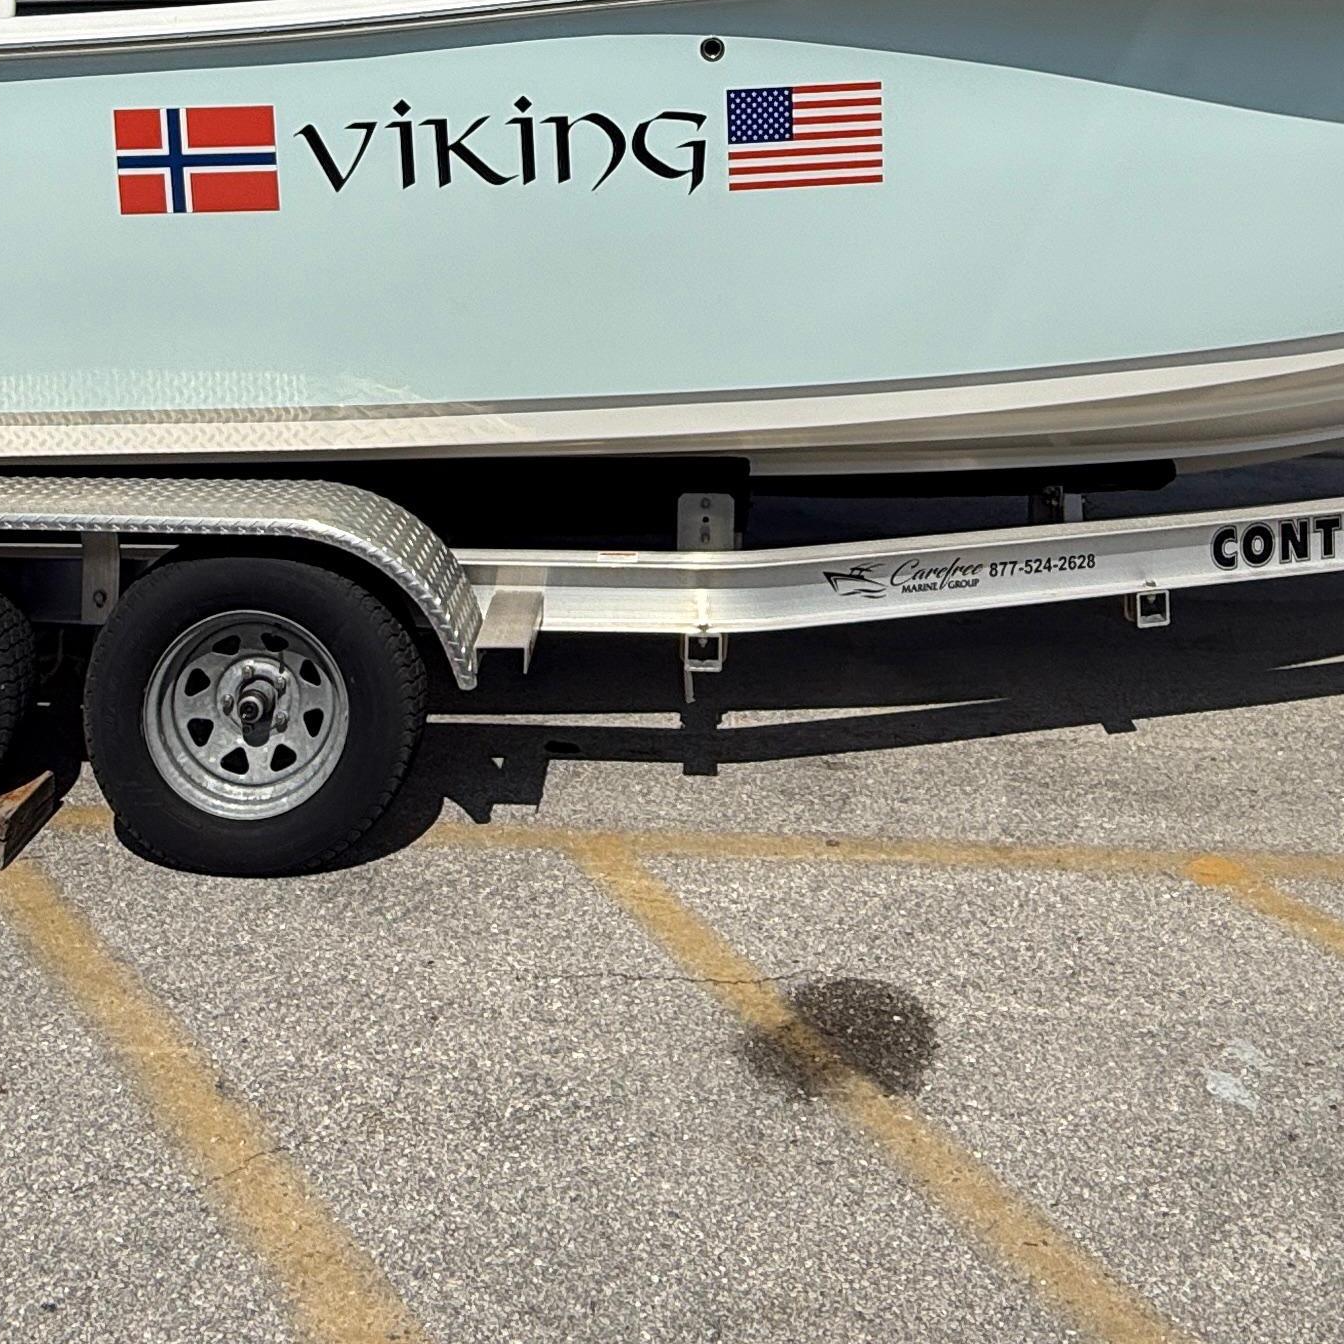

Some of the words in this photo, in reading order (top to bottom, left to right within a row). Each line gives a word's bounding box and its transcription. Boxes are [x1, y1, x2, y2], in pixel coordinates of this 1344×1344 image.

[890, 557, 984, 590] Carefree
[988, 554, 1096, 578] 877-524-2628
[901, 581, 939, 594] MARINE
[947, 578, 980, 590] GROUP
